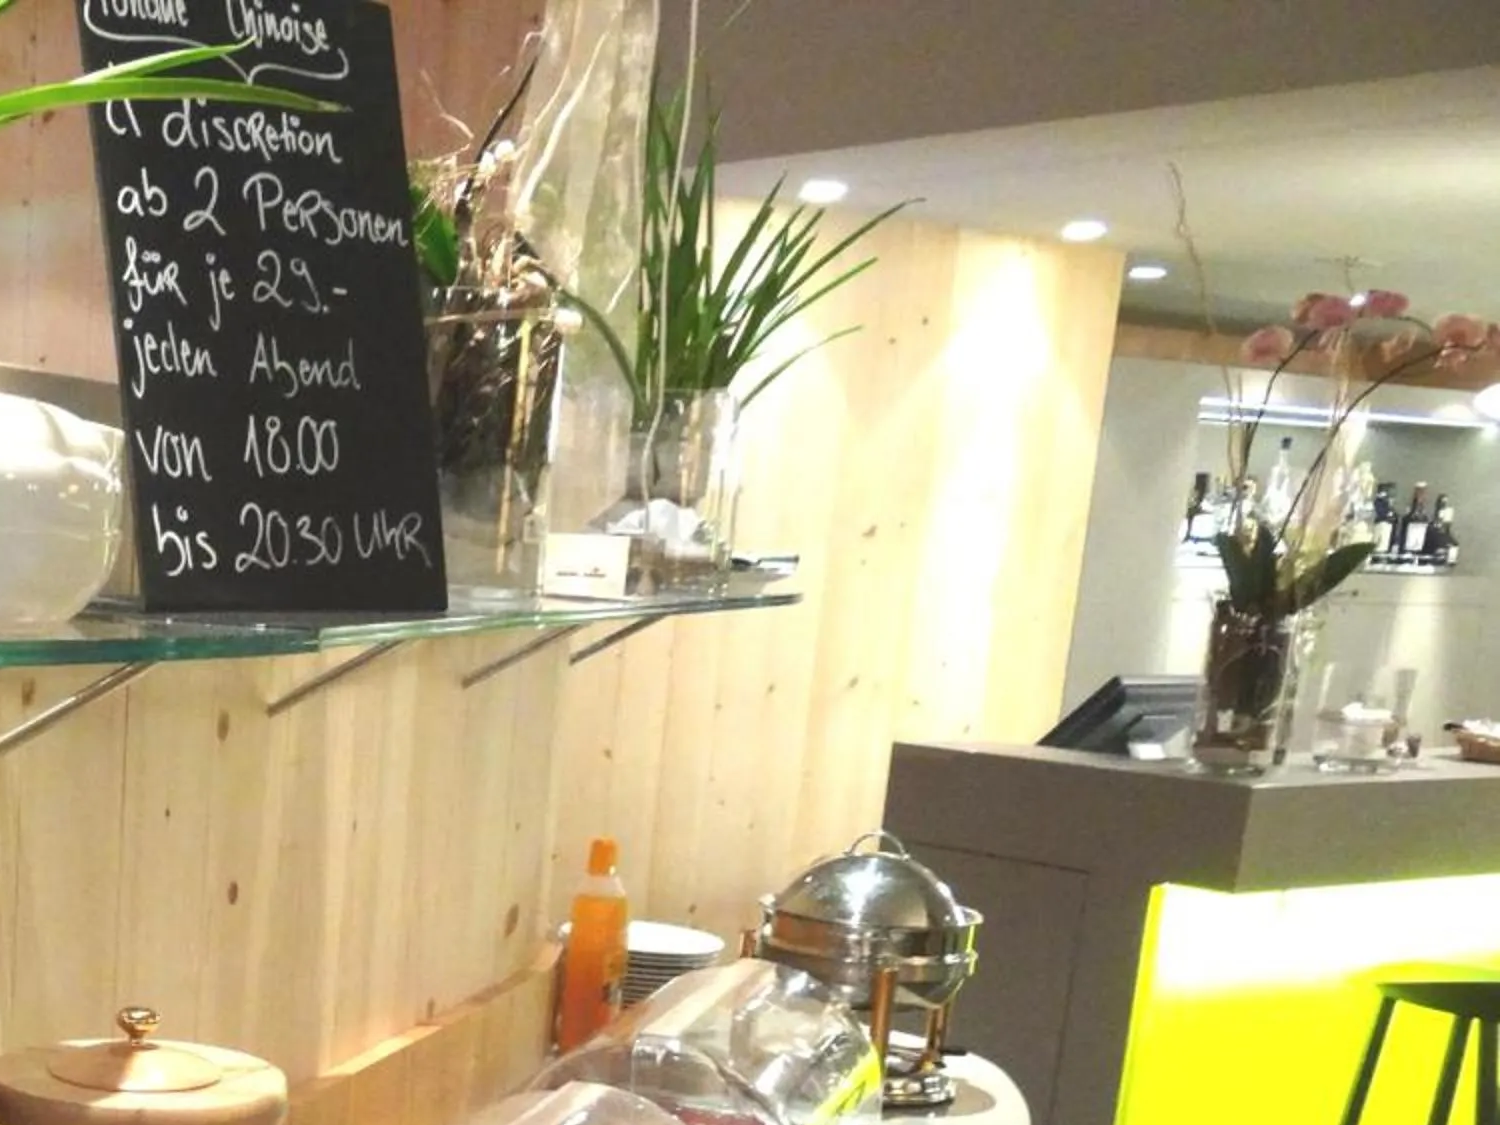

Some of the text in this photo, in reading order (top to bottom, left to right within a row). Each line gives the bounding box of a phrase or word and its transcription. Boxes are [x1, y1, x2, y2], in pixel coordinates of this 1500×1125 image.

[225, 0, 332, 55] Chinoise
[117, 167, 169, 217] ab
[183, 166, 228, 236] 2
[206, 252, 236, 330] je
[123, 318, 362, 399] jeden Abend
[135, 425, 213, 482] von
[151, 503, 218, 577] bis
